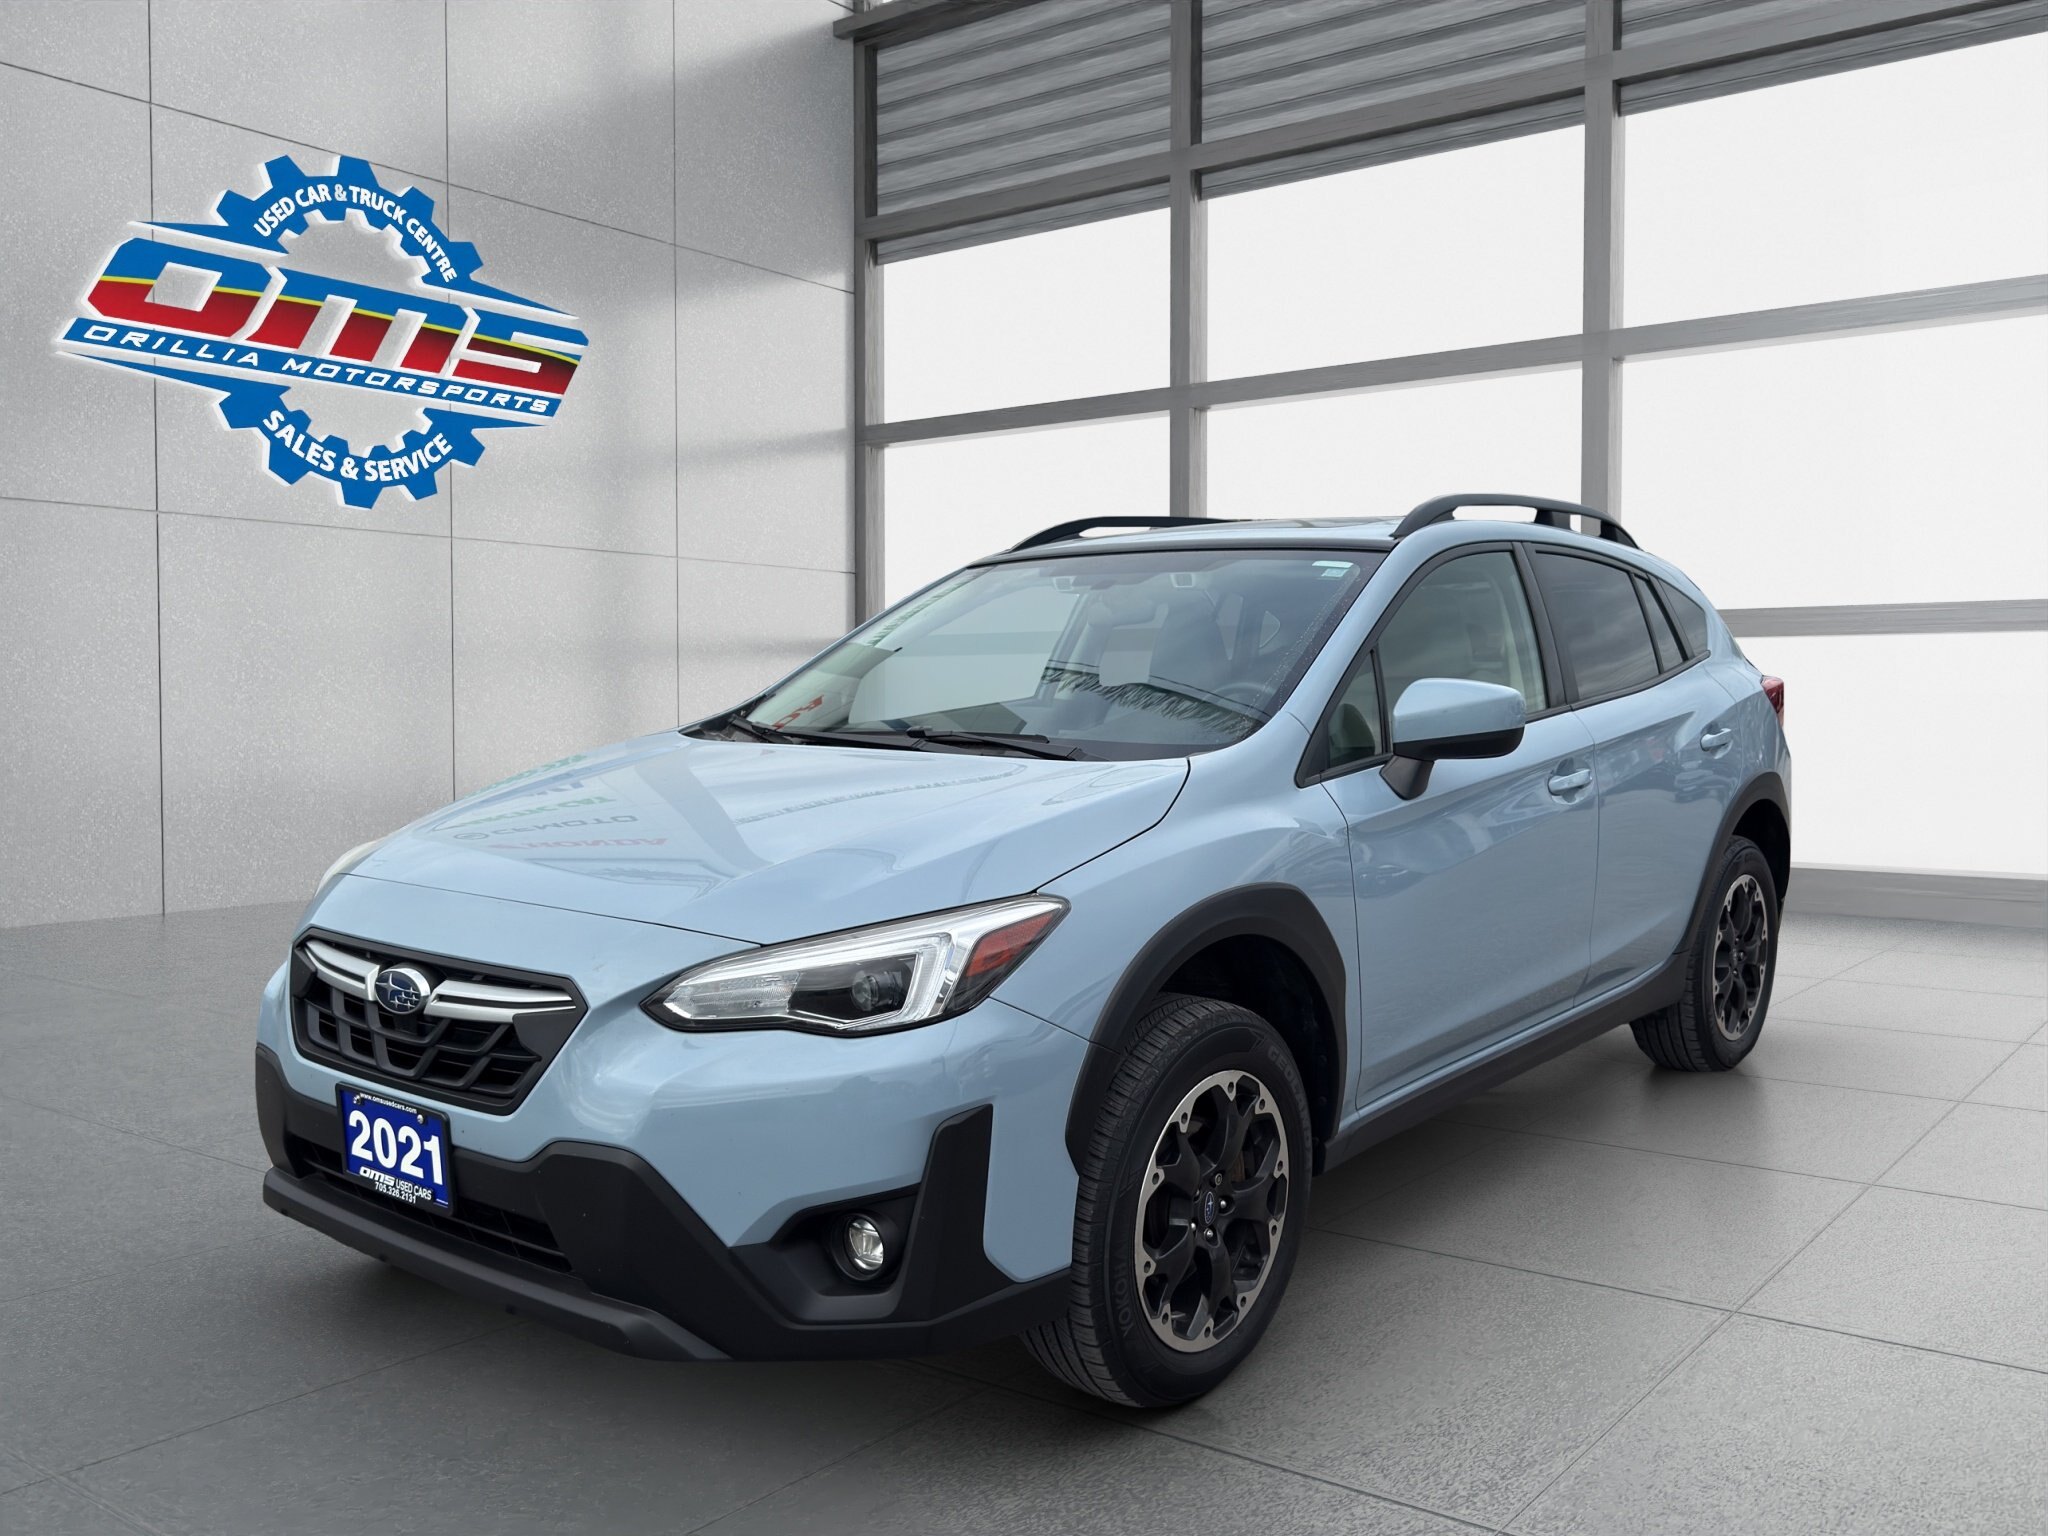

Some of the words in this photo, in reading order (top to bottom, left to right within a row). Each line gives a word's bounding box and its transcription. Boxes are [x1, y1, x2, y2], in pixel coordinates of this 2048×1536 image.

[253, 200, 295, 237] USED
[295, 184, 331, 207] CAR
[334, 183, 347, 202] &
[349, 186, 407, 225] TRUCK
[406, 217, 458, 283] CENTRE
[82, 324, 260, 367] ORILLIA
[281, 358, 550, 413] MOTORSPORTS
[262, 410, 337, 472] SALES
[340, 457, 360, 480] &
[364, 432, 453, 482] SERVICE
[359, 1092, 417, 1115] www.omsusedcars.com
[348, 1109, 443, 1185] 2021
[395, 1178, 414, 1194] USED
[413, 1184, 432, 1201] CARS
